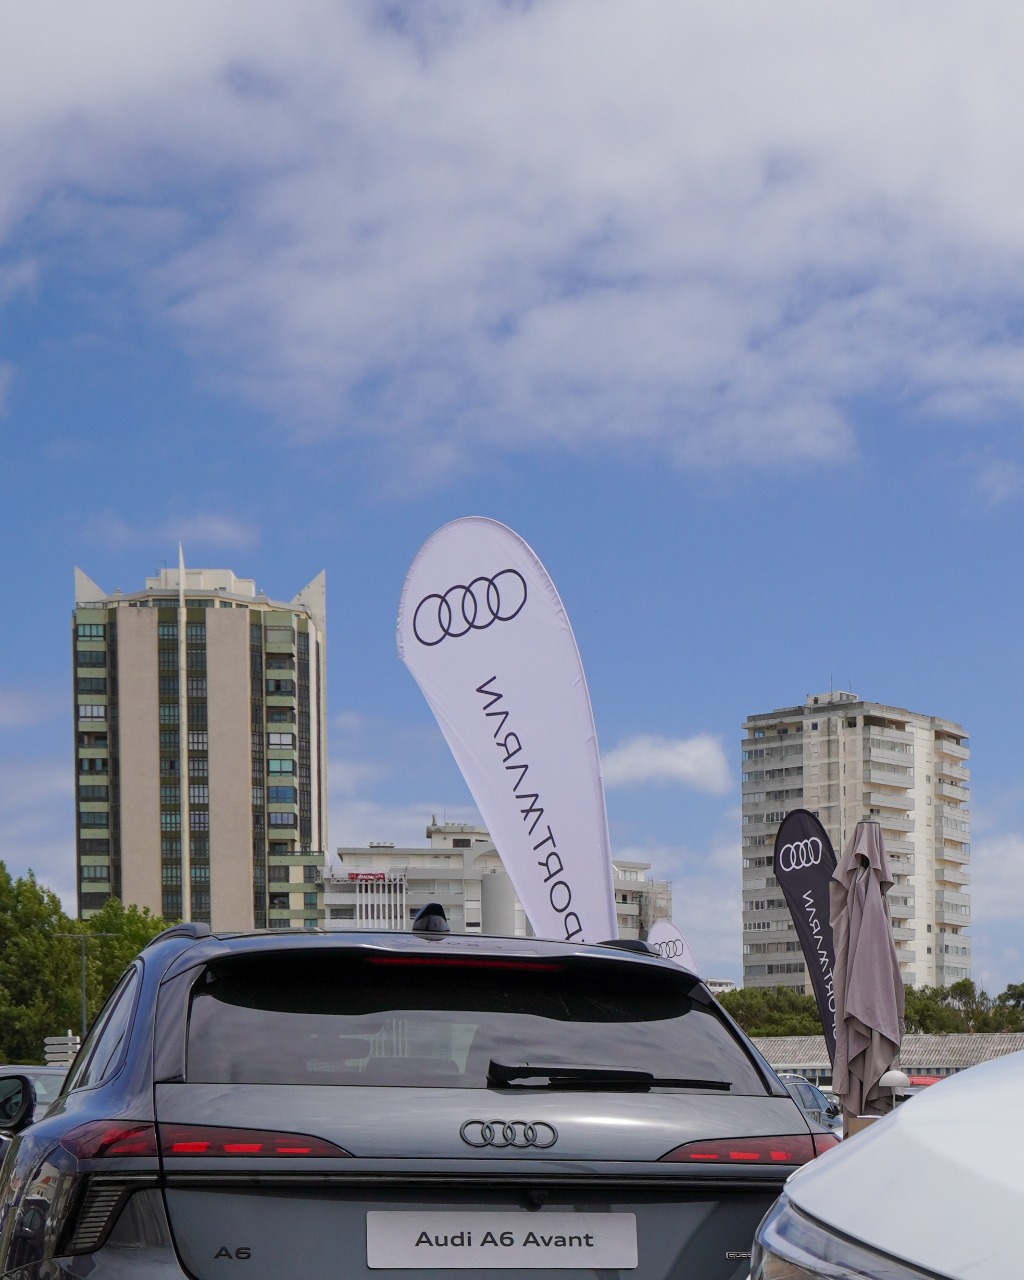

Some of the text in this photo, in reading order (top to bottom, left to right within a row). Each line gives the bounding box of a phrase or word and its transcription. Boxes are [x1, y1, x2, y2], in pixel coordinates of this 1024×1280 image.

[414, 1231, 594, 1247] Audi A6 Avant
[213, 1246, 252, 1260] A6
